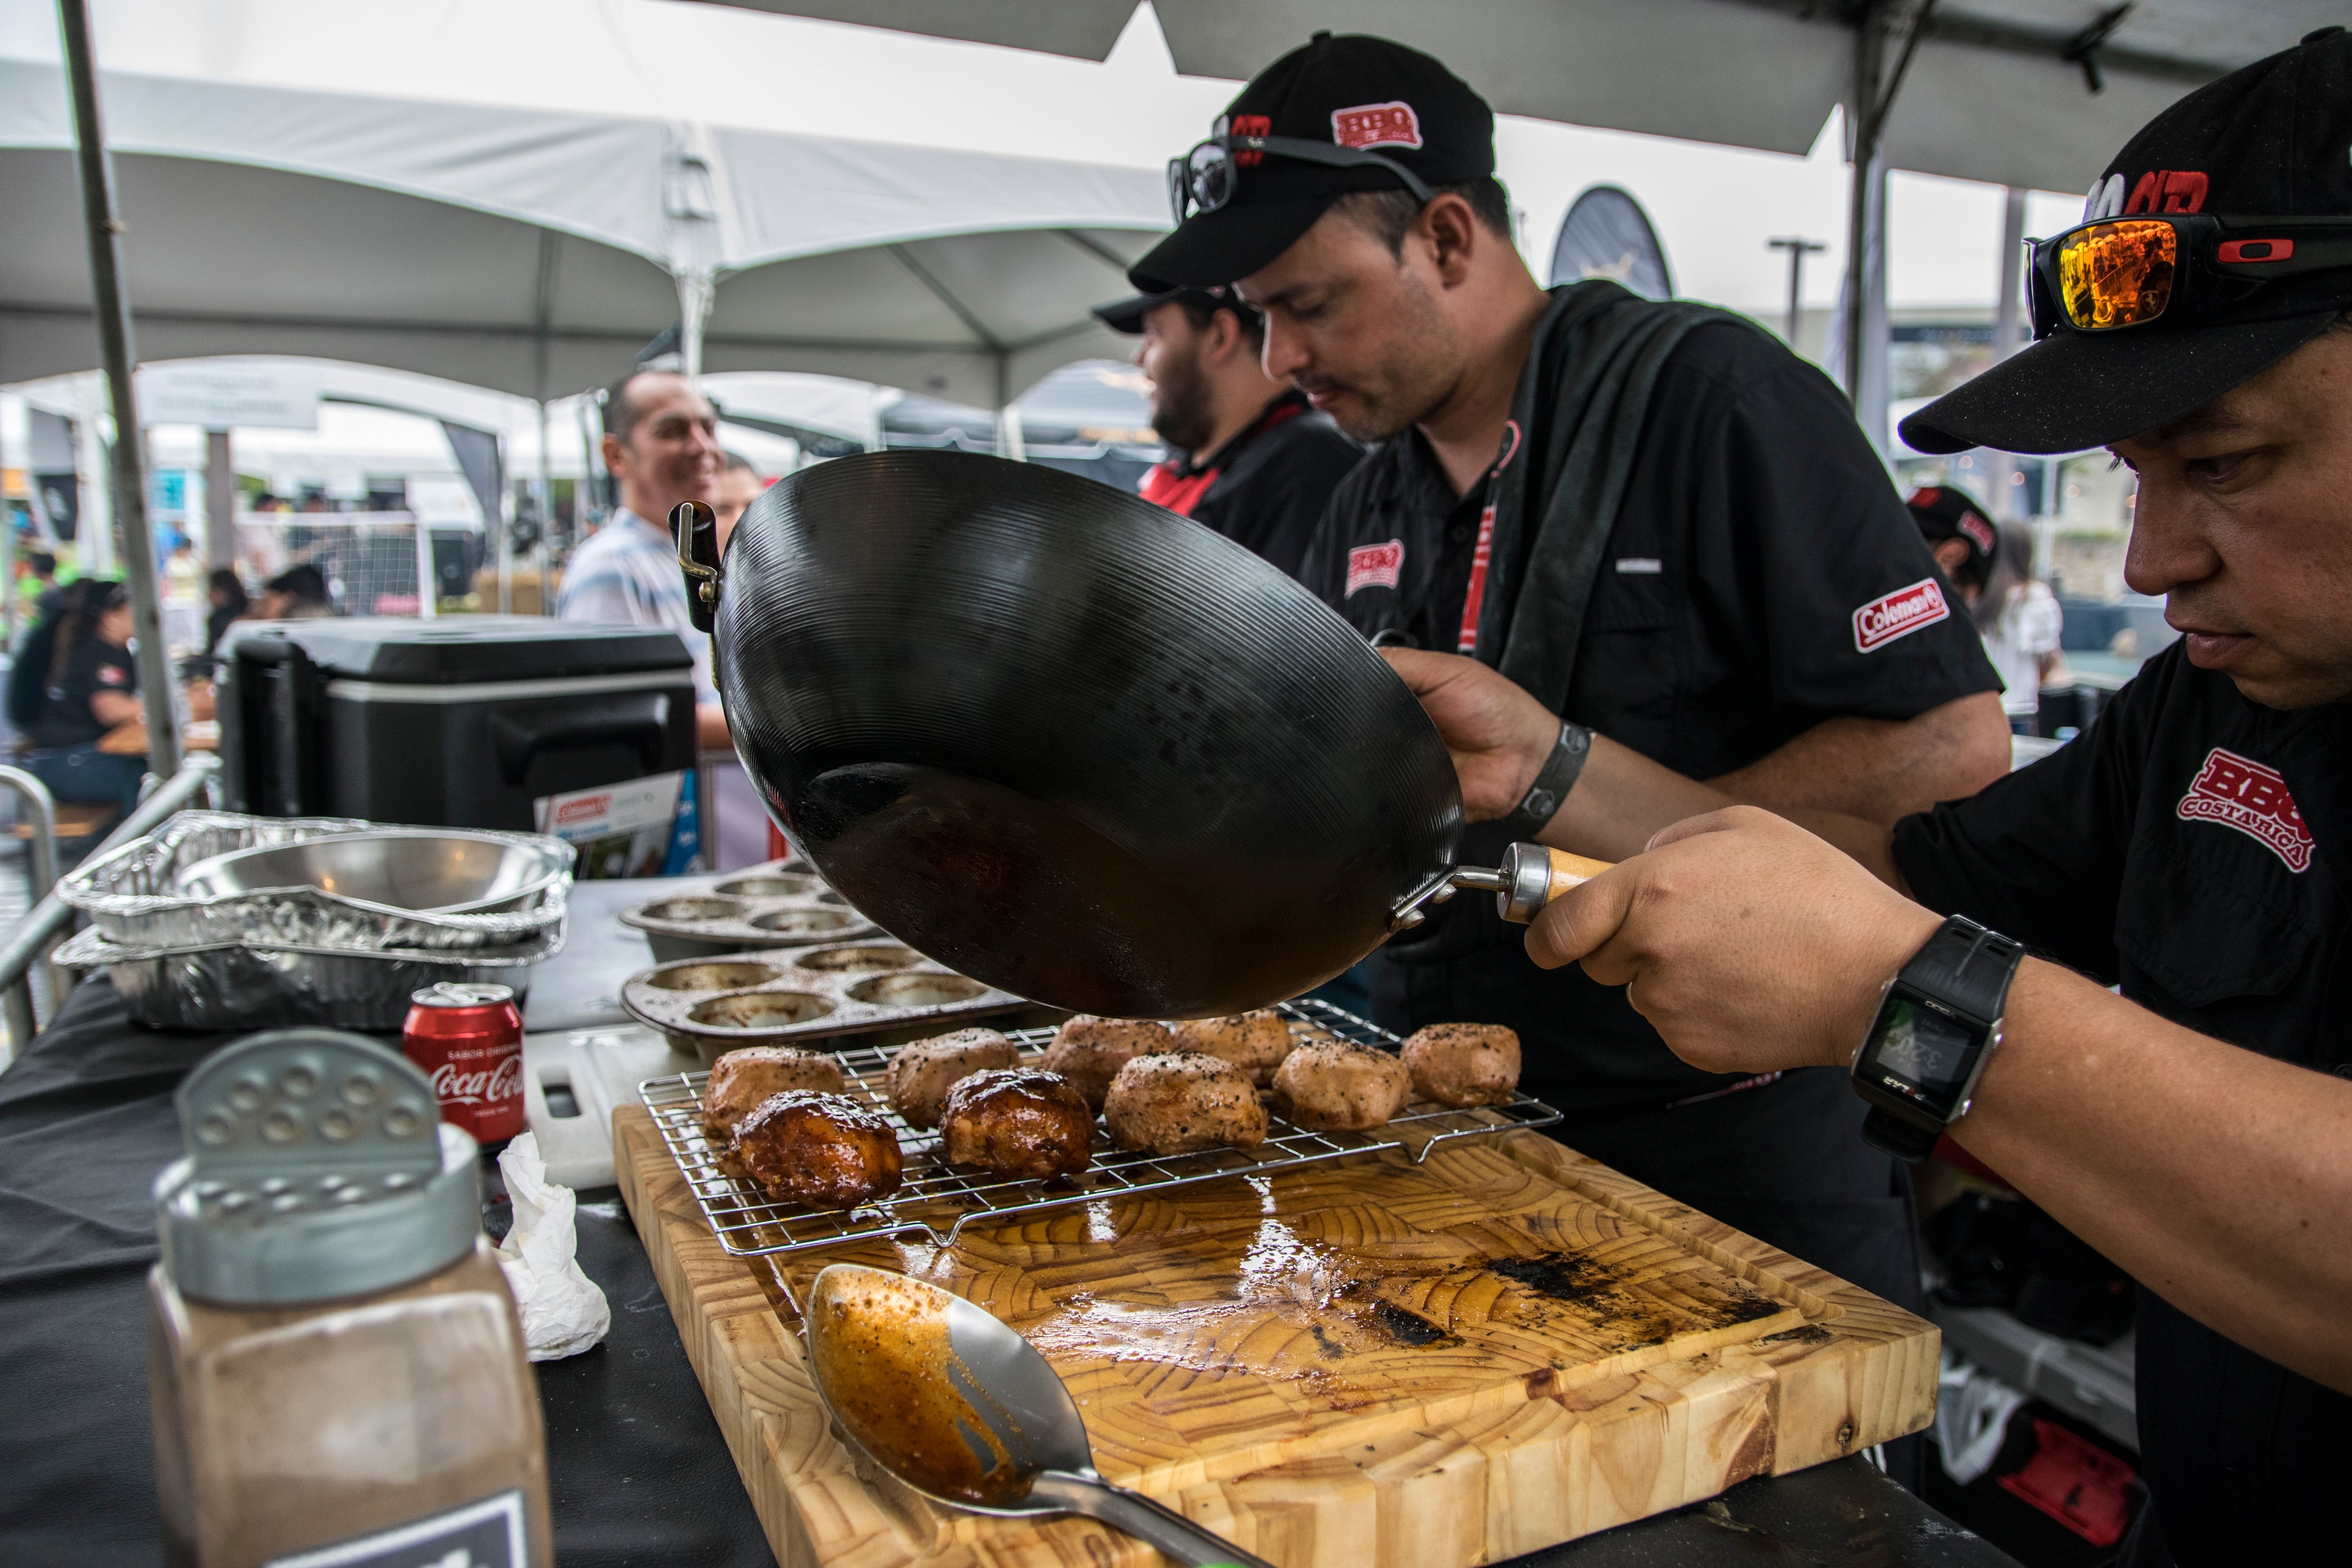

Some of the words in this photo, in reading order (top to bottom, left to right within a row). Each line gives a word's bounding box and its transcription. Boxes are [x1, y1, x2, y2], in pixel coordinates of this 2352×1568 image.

[1859, 594, 1931, 637] Coleman
[2181, 797, 2255, 829] COSTA
[2255, 815, 2305, 866] RICA
[446, 1049, 485, 1061] SABOR
